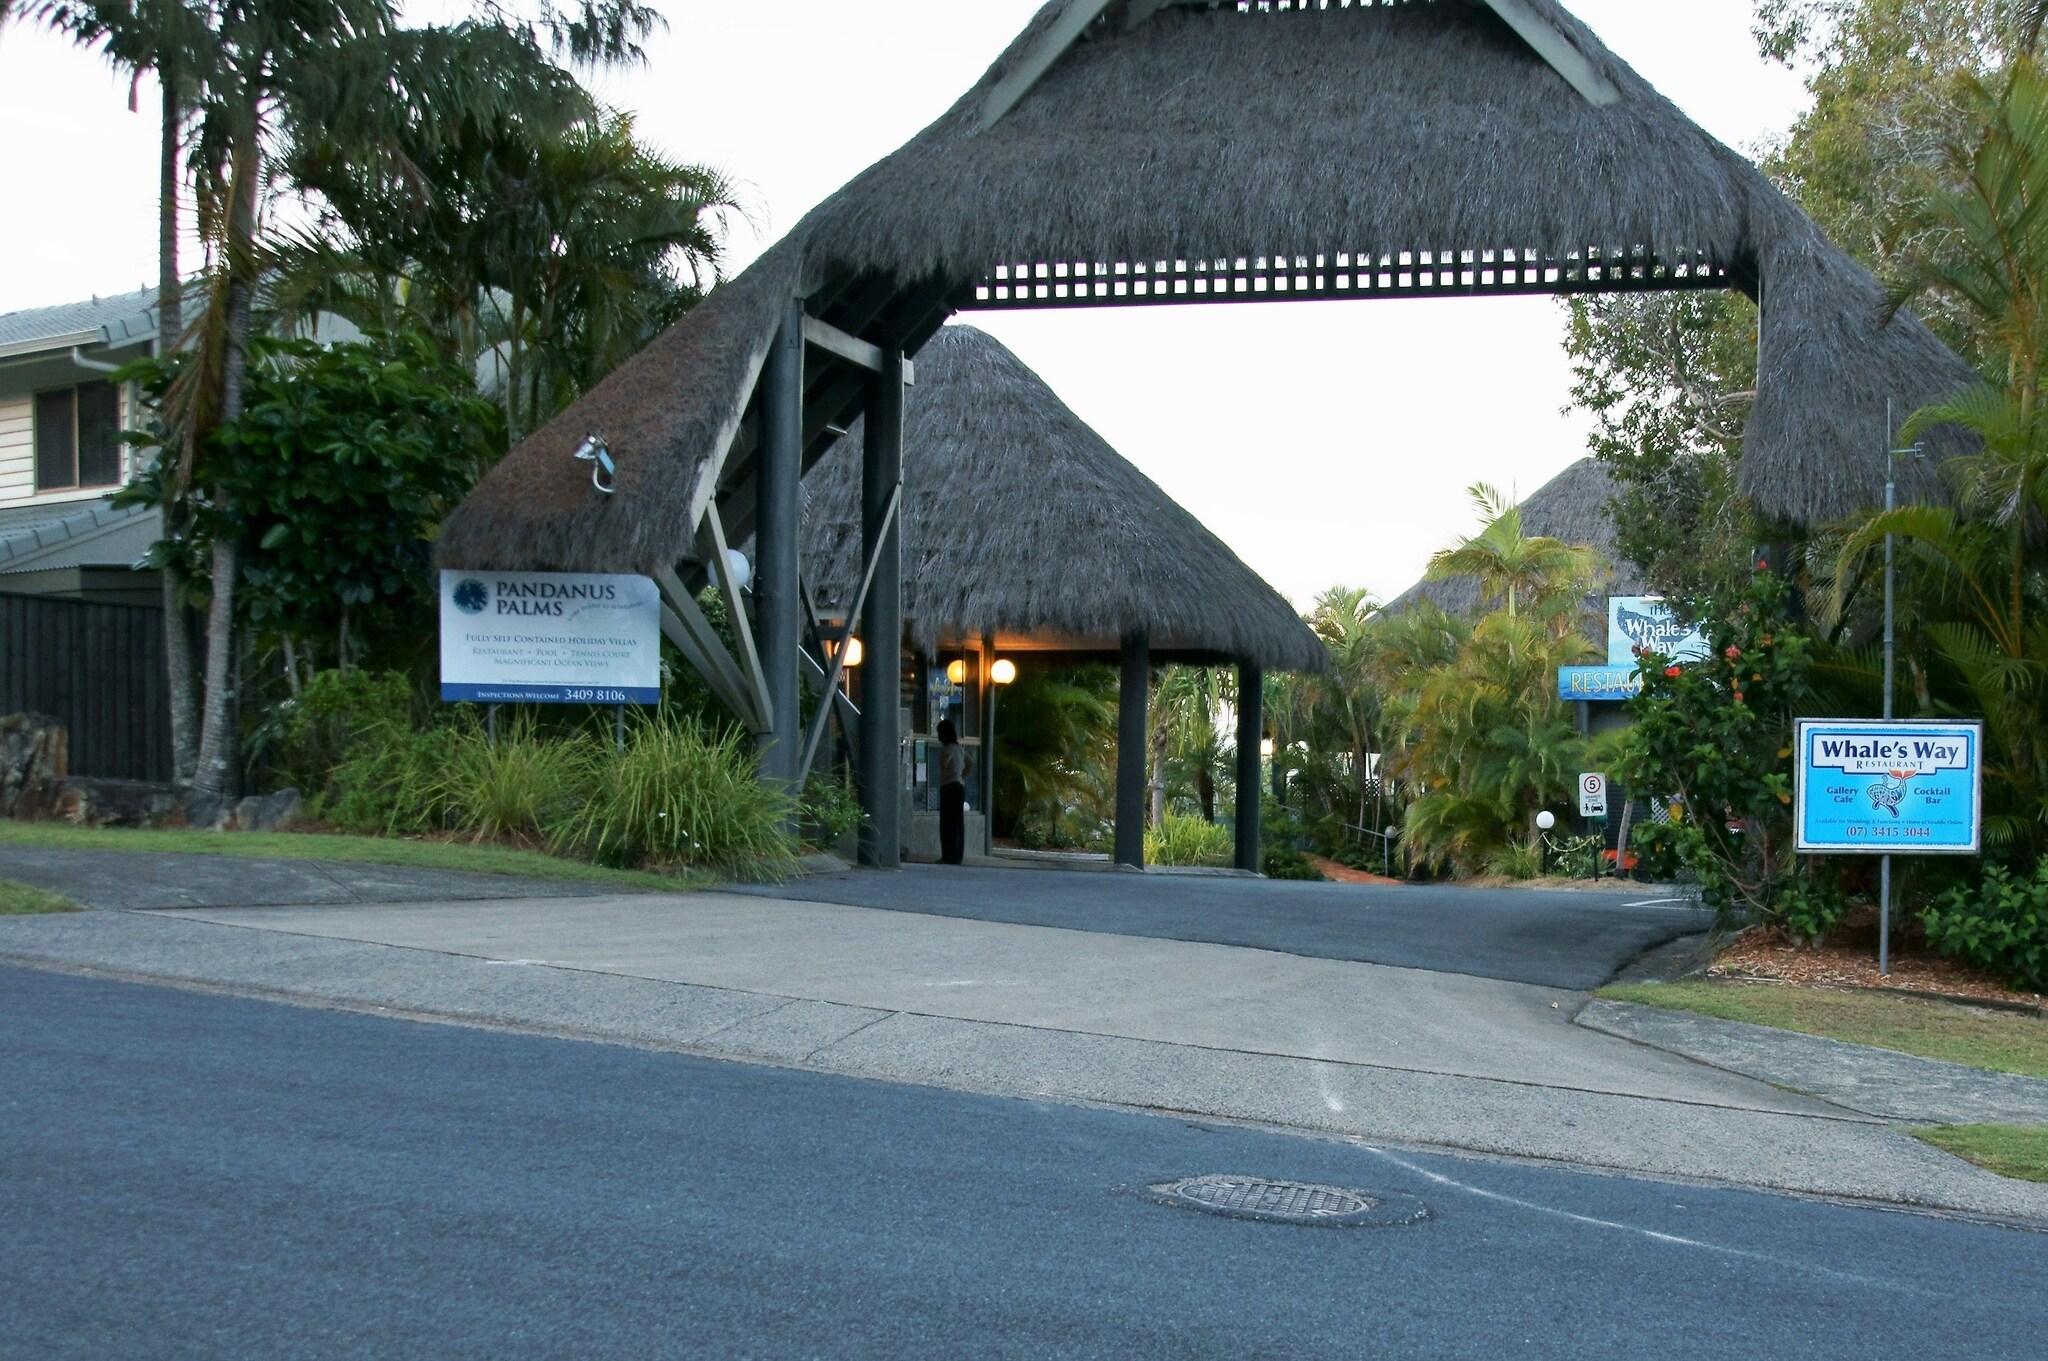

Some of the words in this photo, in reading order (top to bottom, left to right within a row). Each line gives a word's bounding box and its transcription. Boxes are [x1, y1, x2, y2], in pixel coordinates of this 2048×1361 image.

[497, 581, 616, 600] PANDANUS
[497, 600, 563, 616] PALMS
[565, 688, 593, 700] 3409
[597, 689, 625, 701] 8106
[1821, 740, 1908, 759] Whale's
[1913, 741, 1959, 764] Way
[1589, 779, 1596, 789] 5
[1826, 786, 1859, 796] Gallery
[1914, 787, 1950, 796] Cocktail
[1833, 796, 1853, 804] Cafe
[1925, 796, 1941, 804] Bar
[1846, 826, 1868, 838] (07)
[1871, 827, 1899, 837] 3415
[1903, 827, 1930, 837] 3044
